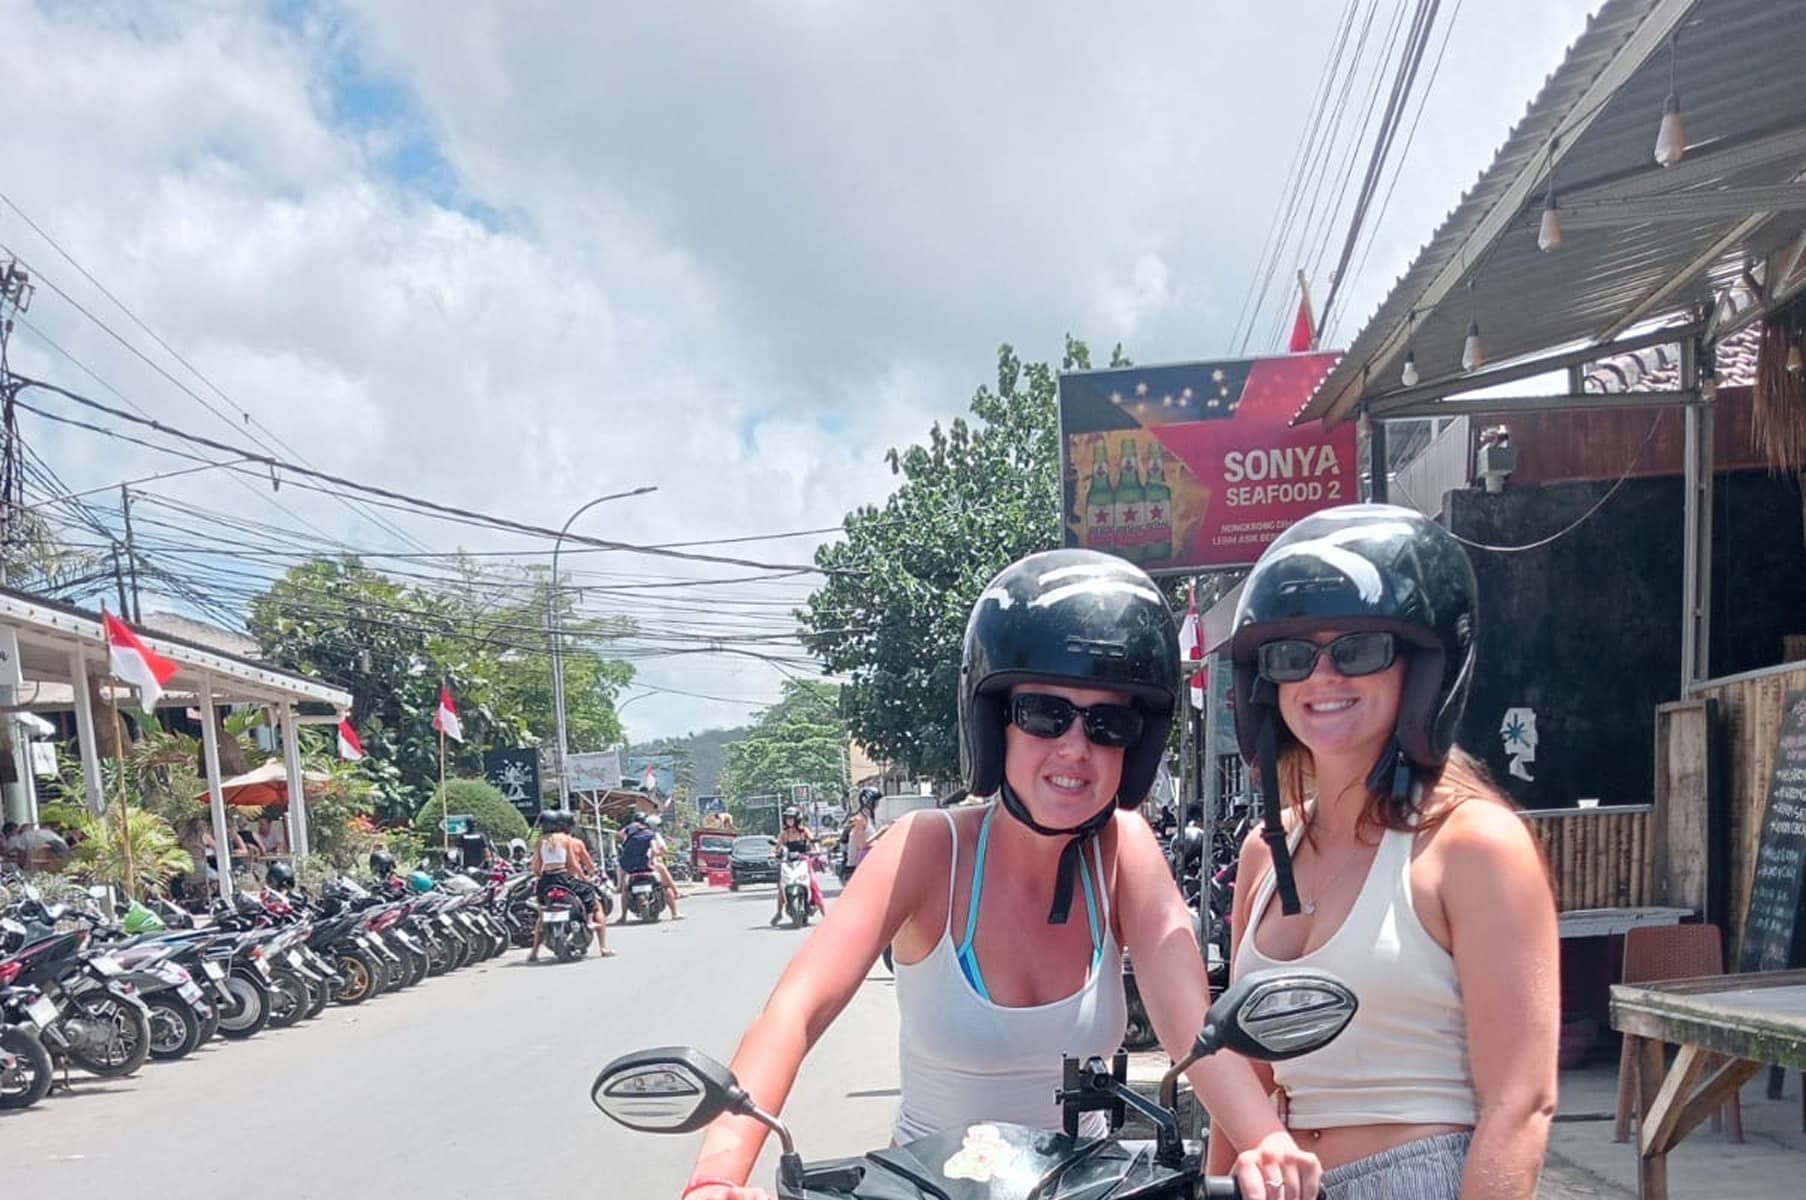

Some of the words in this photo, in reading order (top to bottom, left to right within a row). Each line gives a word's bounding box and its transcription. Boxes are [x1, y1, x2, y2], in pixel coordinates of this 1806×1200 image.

[1223, 444, 1341, 482] SONYA
[1225, 482, 1322, 507] SEAFOOD
[1327, 481, 1341, 499] 2
